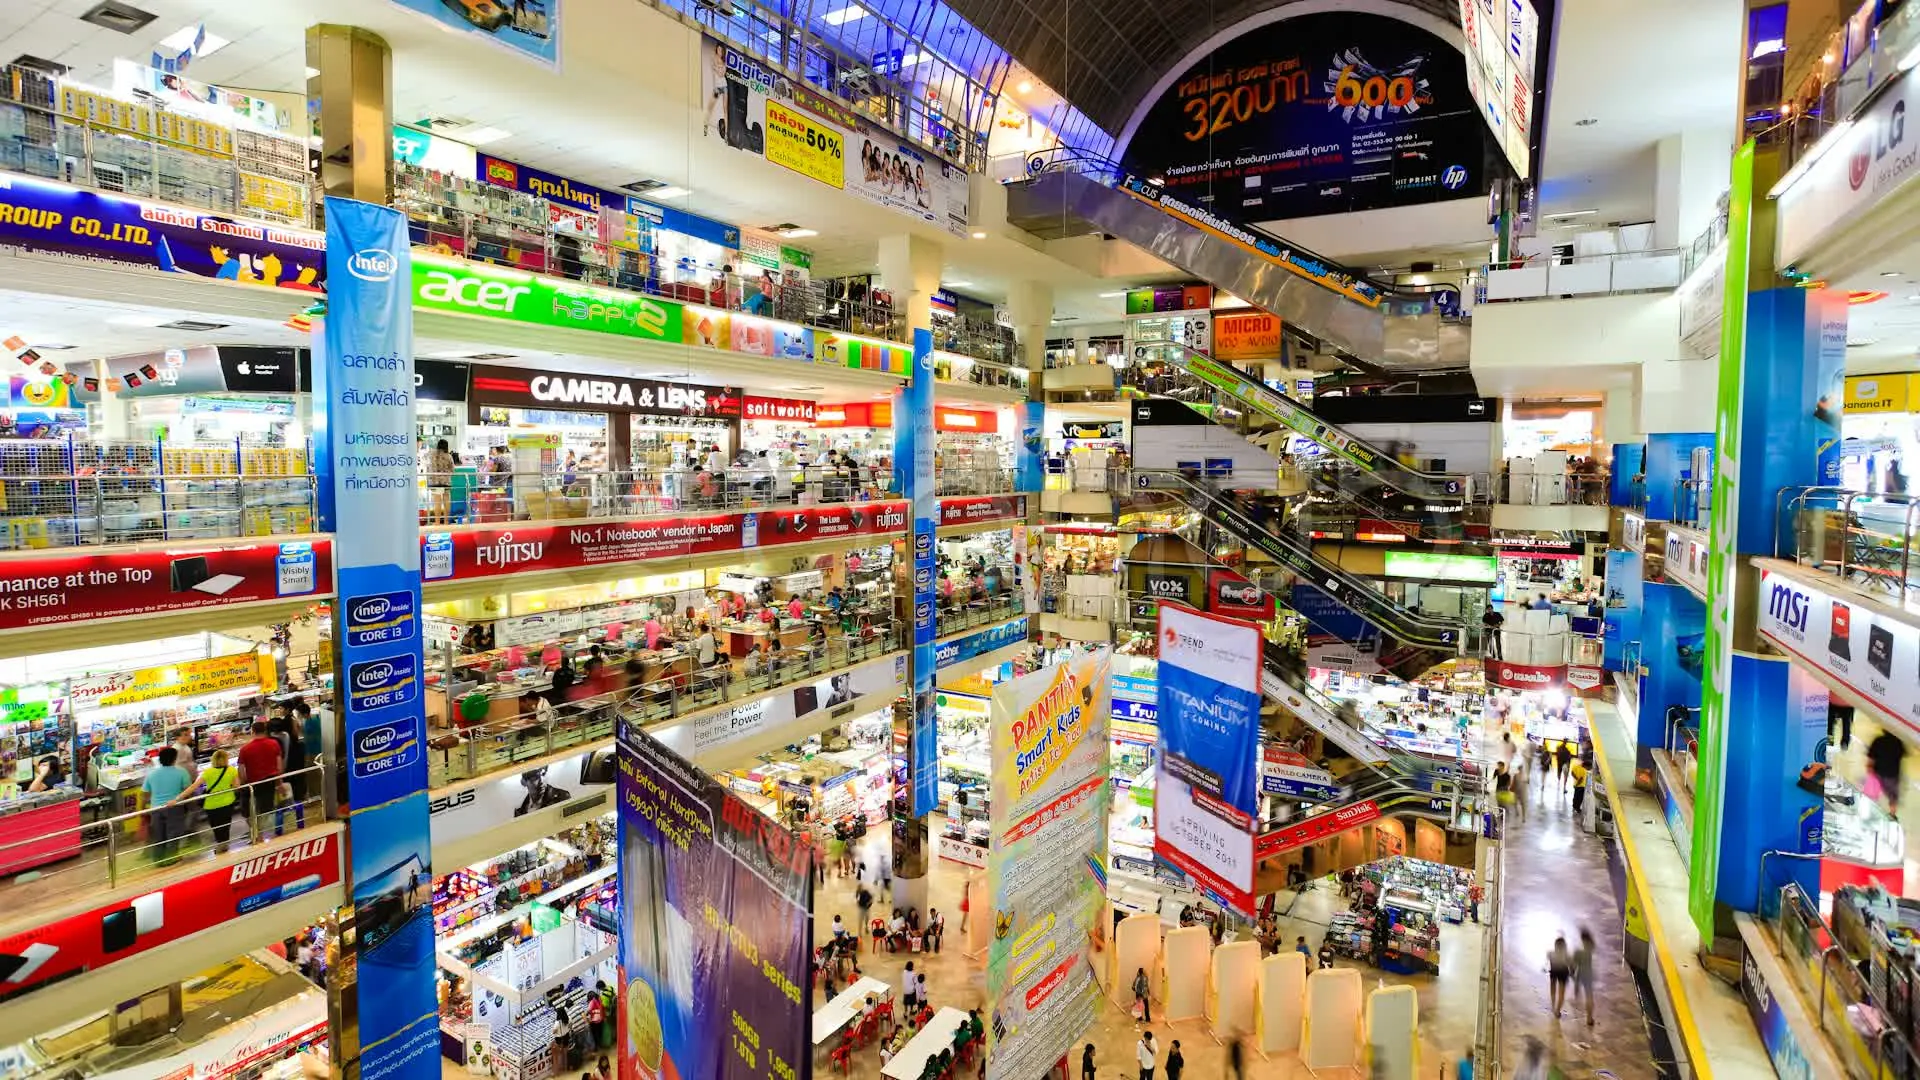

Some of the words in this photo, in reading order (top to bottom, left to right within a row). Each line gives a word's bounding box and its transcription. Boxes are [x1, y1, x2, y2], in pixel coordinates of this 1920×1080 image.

[726, 50, 777, 89] Digital
[1335, 65, 1414, 107] 600
[806, 127, 841, 159] 50%
[1876, 99, 1905, 162] LG
[1409, 174, 1437, 184] PRINT
[1446, 165, 1466, 189] hp
[528, 176, 600, 211] คุณใหญ่
[70, 216, 152, 245] CO.,LTD.
[420, 271, 531, 312] acer
[1438, 290, 1448, 305] 4
[553, 297, 637, 327] happy
[1223, 317, 1271, 334] MICRO
[343, 351, 405, 372] ฉลาดล้ำ
[342, 387, 409, 407] สัมผัสได้
[530, 376, 634, 406] CAMERA
[639, 388, 654, 407] &
[658, 386, 706, 410] LENS
[1882, 398, 1893, 409] IT
[746, 402, 813, 419] softworld
[1448, 481, 1457, 493] 3
[663, 526, 695, 537] vendor
[698, 524, 706, 534] in
[708, 523, 734, 536] Japan
[876, 506, 904, 529] FUJITSU
[476, 532, 542, 568] FUJITSU
[1668, 536, 1683, 562] msi
[65, 572, 84, 587] at
[89, 570, 118, 584] the
[121, 568, 152, 583] Top
[281, 565, 310, 576] Visibly
[282, 576, 307, 585] Smart
[1, 597, 12, 610] K
[17, 593, 66, 608] SH561
[1769, 581, 1810, 632] msi
[360, 628, 387, 643] CORE
[392, 627, 402, 637] i3
[935, 644, 959, 660] rother
[363, 693, 390, 708] CORE
[395, 690, 405, 701] i5
[1164, 685, 1249, 729] TITANIUM
[694, 713, 715, 728] Hear
[716, 710, 730, 721] the
[731, 702, 761, 717] Power
[694, 727, 713, 741] Feel
[715, 722, 728, 735] the
[731, 710, 763, 729] Power
[1016, 727, 1053, 775] Smart
[1056, 706, 1080, 737] Kids
[367, 757, 393, 773] CORE
[397, 753, 407, 765] i7
[636, 769, 668, 804] External
[1018, 758, 1047, 798] Artist
[1296, 772, 1328, 782] CAMERA
[1336, 803, 1372, 821] SanDisk
[1431, 800, 1442, 810] M
[1179, 815, 1225, 848] ARRIVING
[229, 836, 327, 885] BUFFALO
[475, 955, 502, 973] CASIO
[732, 1010, 760, 1050] 500GB
[732, 1034, 756, 1070] 1.0TB
